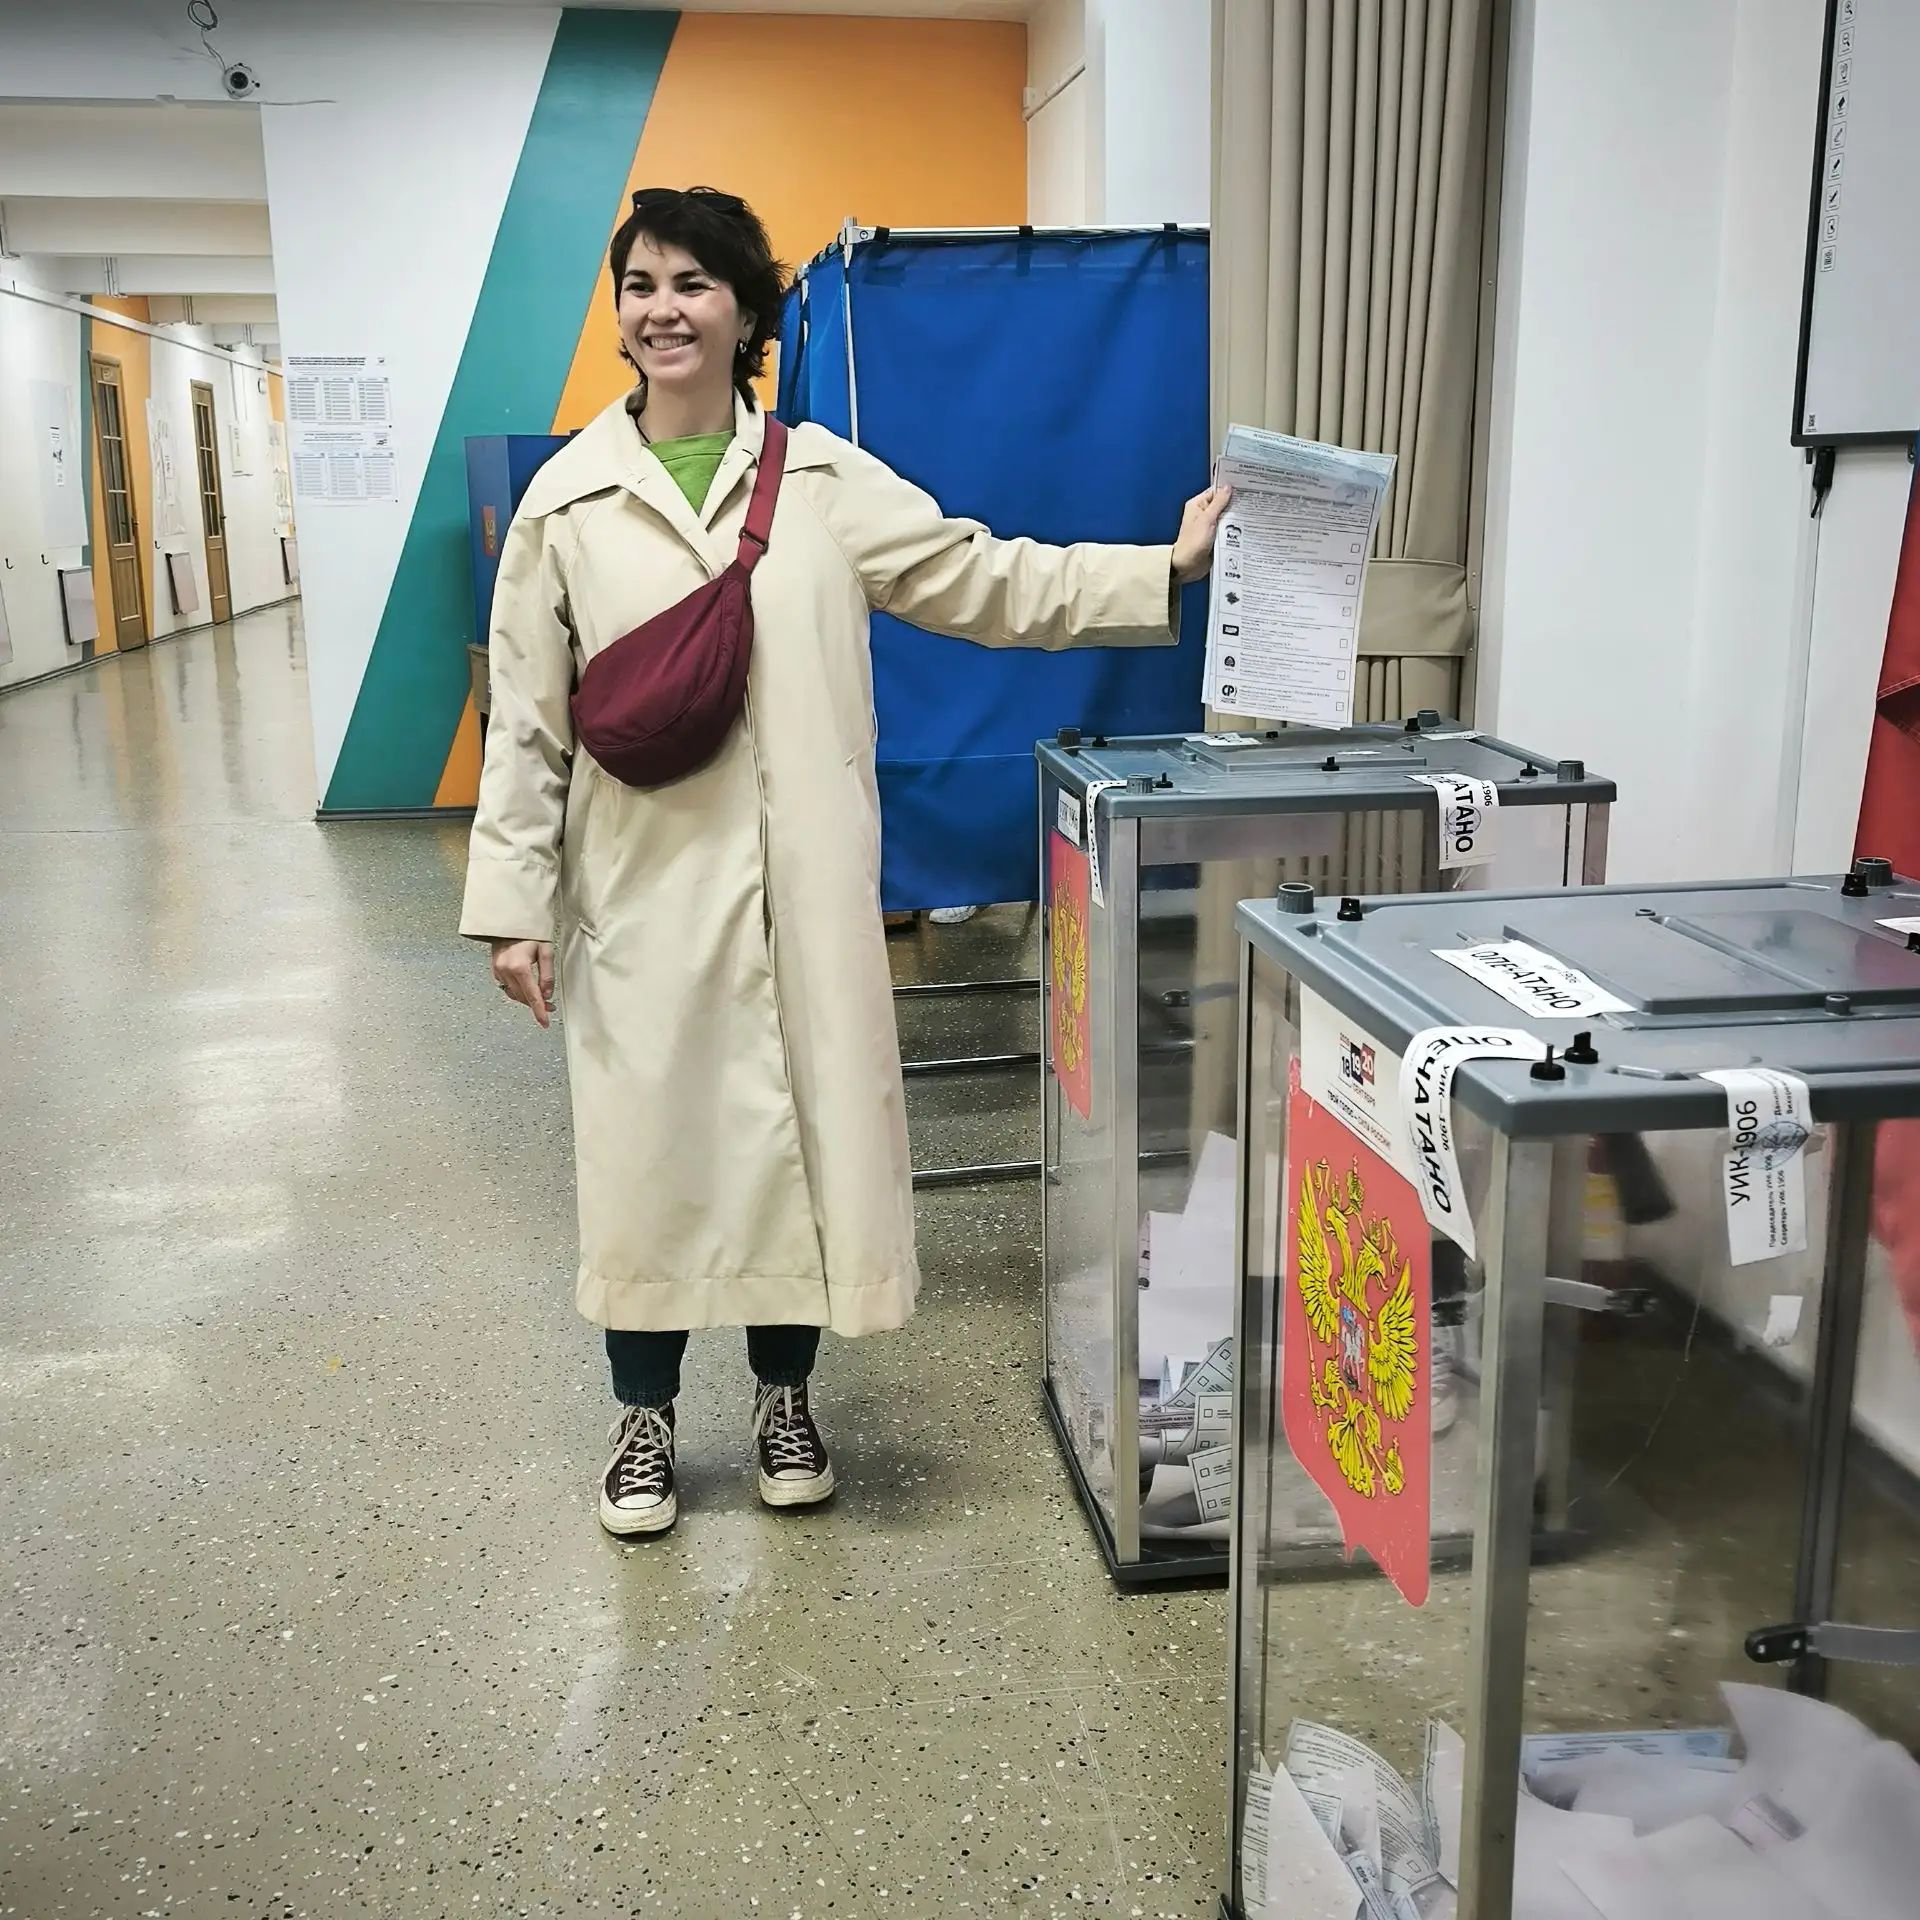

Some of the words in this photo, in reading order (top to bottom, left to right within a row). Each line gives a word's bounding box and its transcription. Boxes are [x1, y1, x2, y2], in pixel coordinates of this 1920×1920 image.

[1352, 1052, 1362, 1076] 19
[1362, 1050, 1374, 1076] 20
[1414, 1036, 1512, 1214] ОПЕЧАТАНО
[1729, 1100, 1758, 1206] УИК-1906
